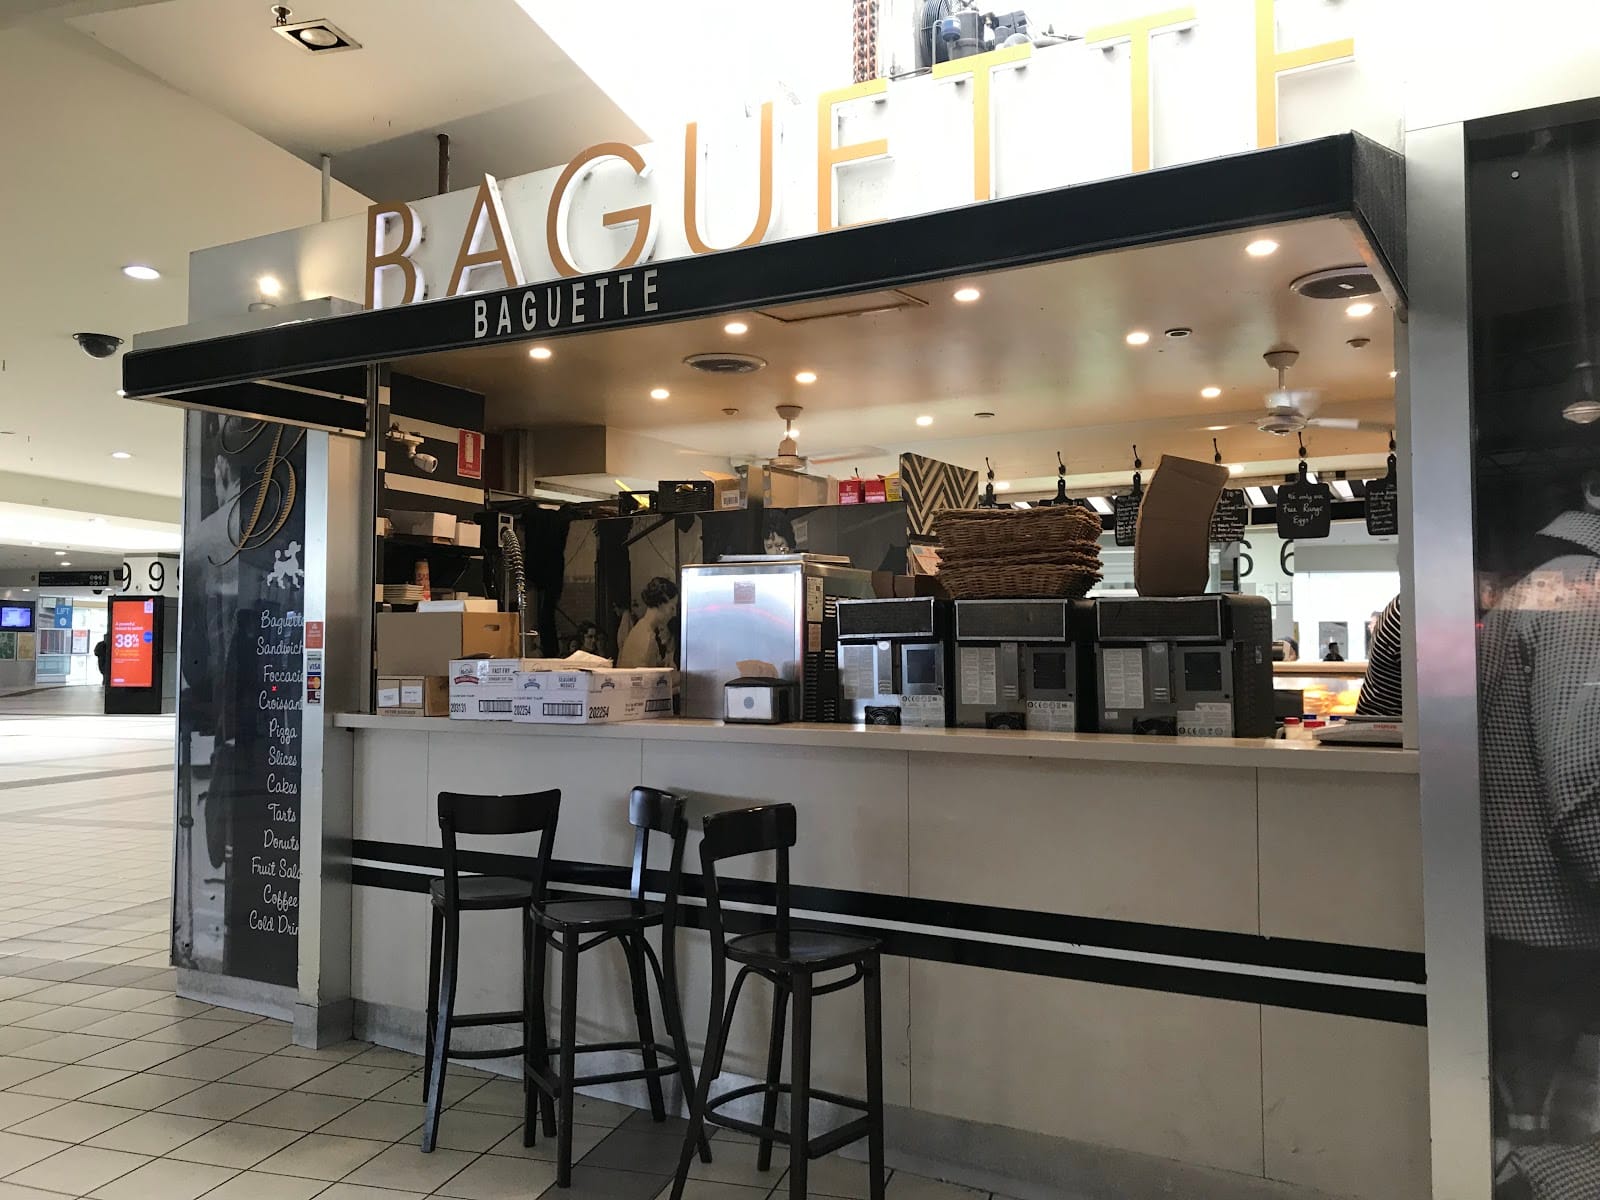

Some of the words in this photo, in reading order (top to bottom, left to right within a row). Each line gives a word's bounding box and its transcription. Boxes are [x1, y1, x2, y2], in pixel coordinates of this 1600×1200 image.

[474, 268, 659, 339] BAGUETTE
[1282, 502, 1298, 513] Free
[1303, 502, 1324, 517] Range
[148, 561, 165, 592] 9
[56, 607, 70, 615] LIFT
[513, 704, 531, 716] 202254
[588, 705, 610, 719] 202254
[269, 718, 298, 744] Pizza
[268, 745, 298, 766] Slices
[267, 772, 298, 794] Cakes
[267, 802, 297, 823] Tarts
[263, 828, 300, 851] Donuts
[251, 856, 276, 877] Fruit
[263, 884, 298, 912] Coffee
[249, 909, 275, 931] Cold
